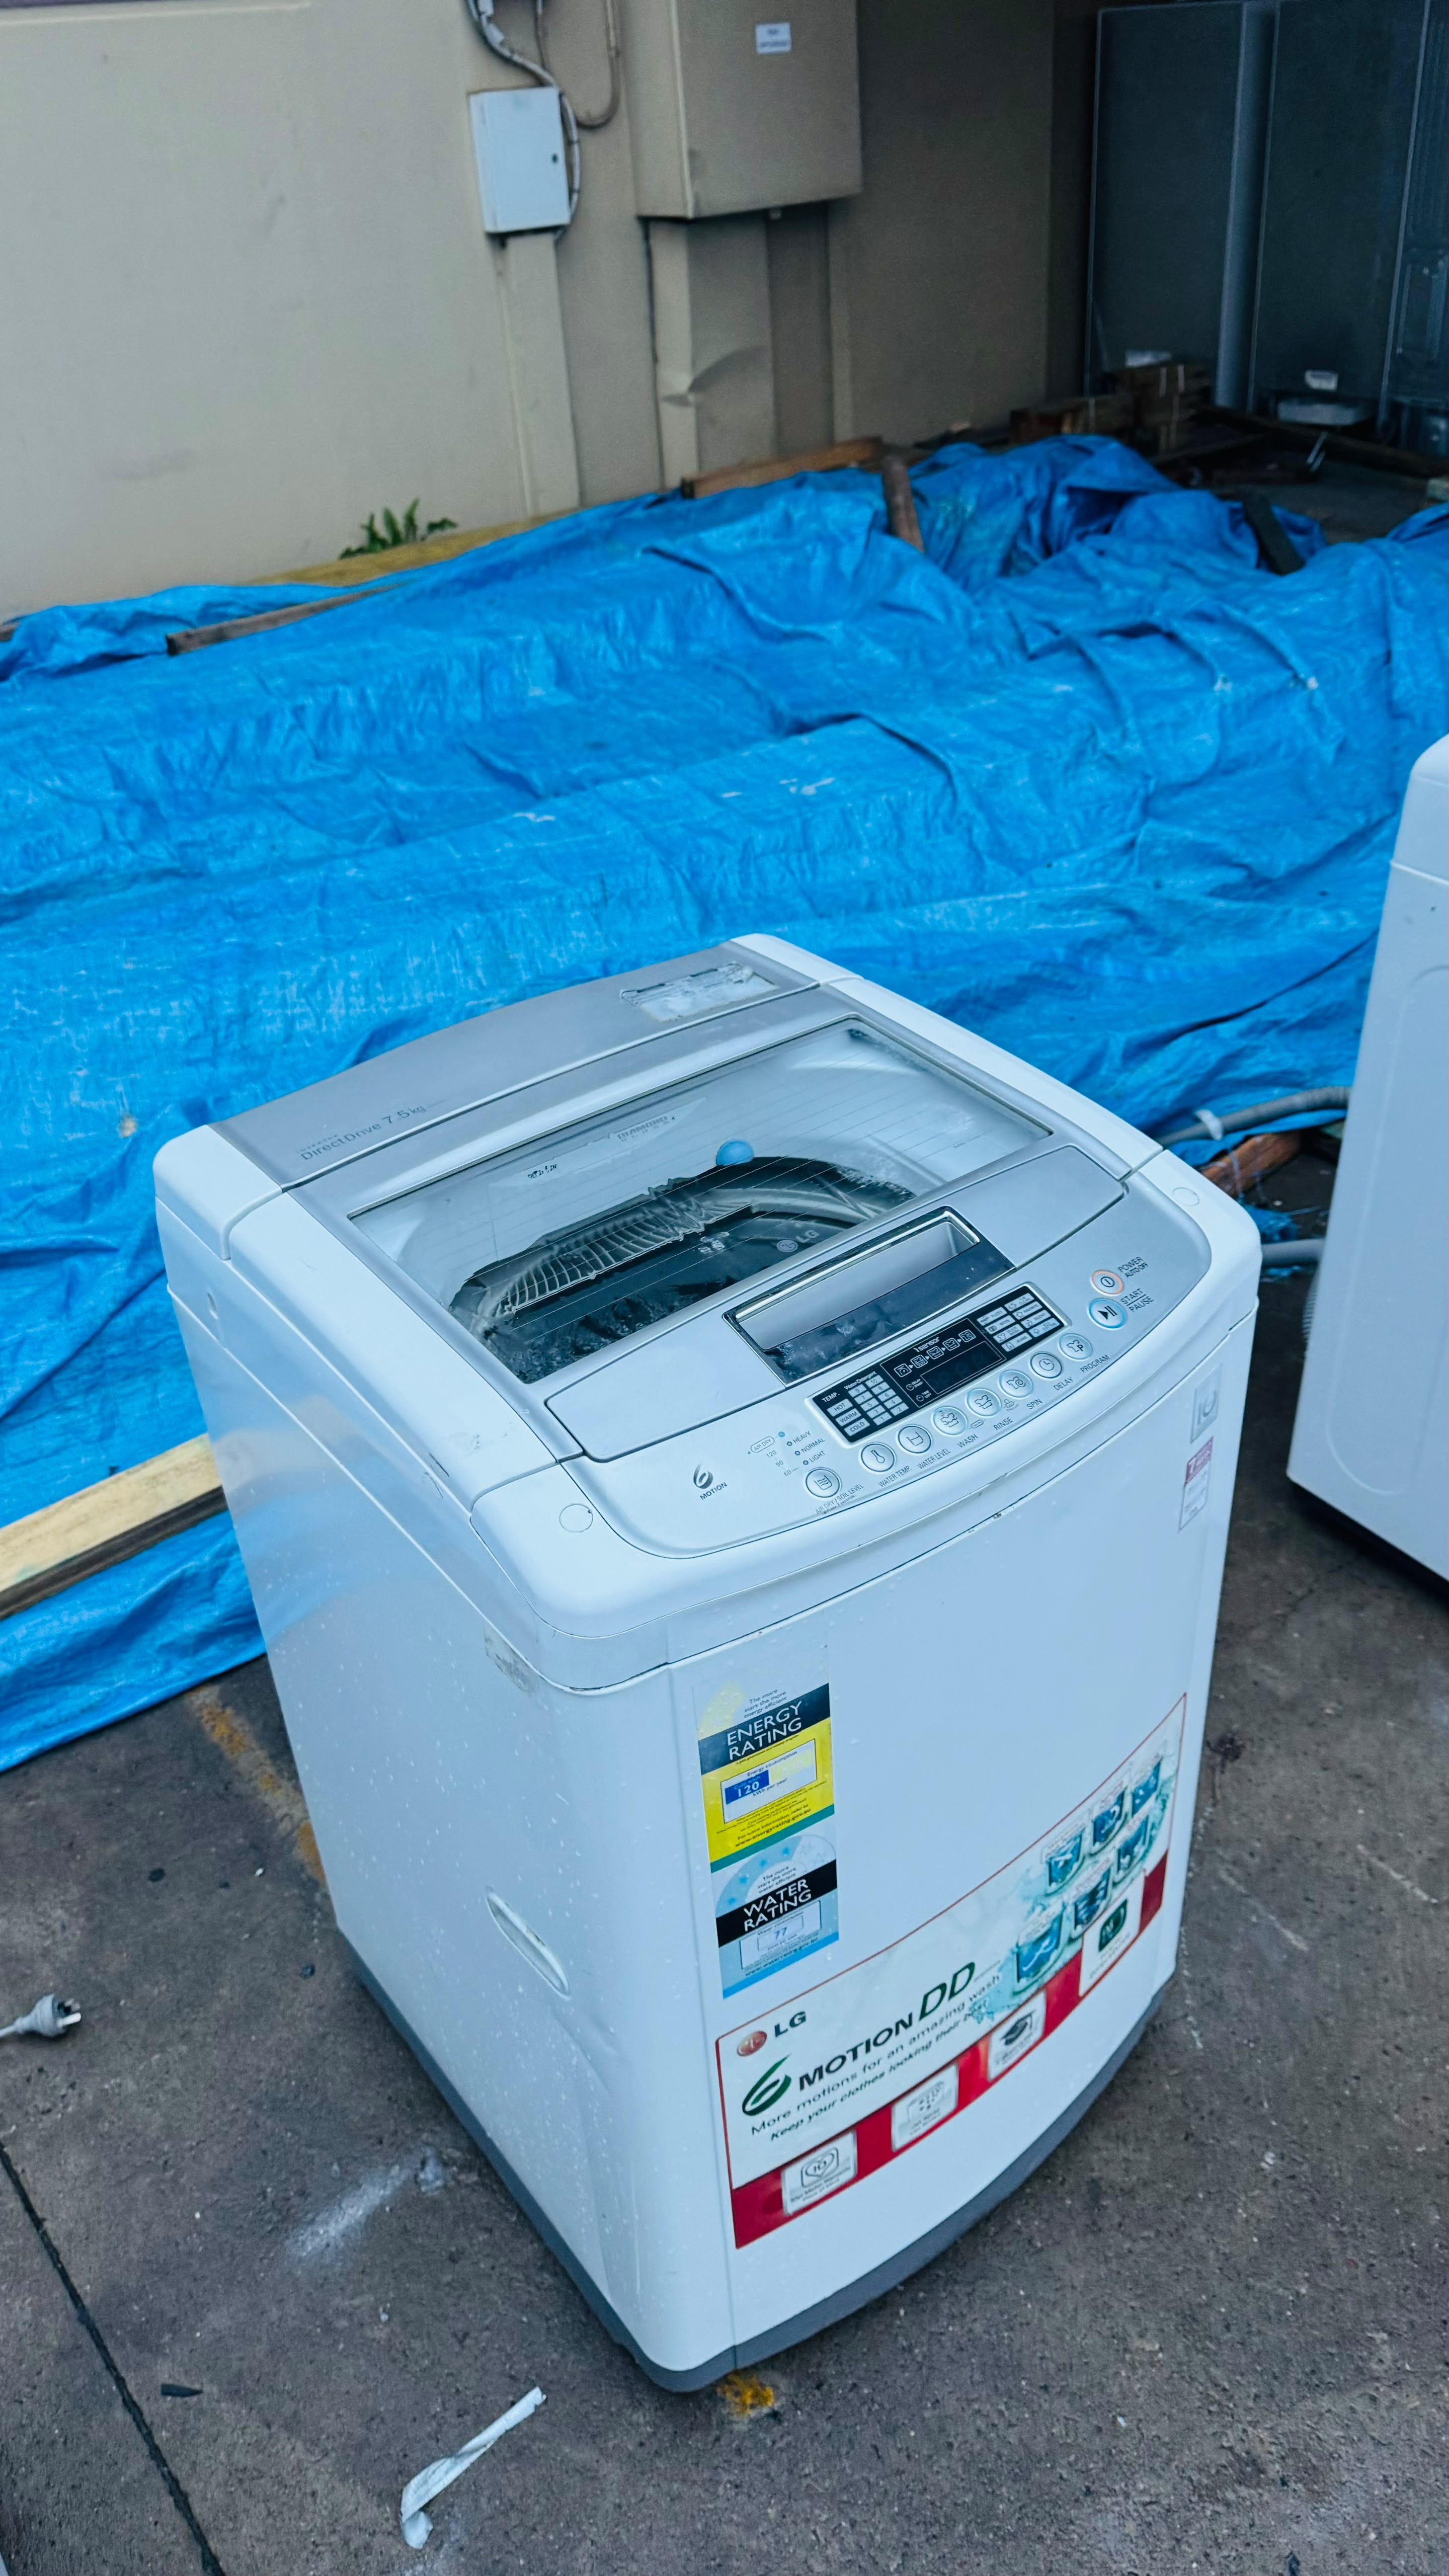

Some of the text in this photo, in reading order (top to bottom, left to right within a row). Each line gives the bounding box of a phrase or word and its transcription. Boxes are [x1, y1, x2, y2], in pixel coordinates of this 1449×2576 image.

[795, 1230, 819, 1243] LG
[1118, 1256, 1144, 1273] POWER
[1120, 1288, 1143, 1304] START
[1129, 1296, 1154, 1312] PAUSE
[1080, 1354, 1110, 1373] PROGRAM
[1054, 1376, 1074, 1391] DELAY
[822, 1392, 840, 1403] TEMP.
[1026, 1398, 1043, 1410] SPIN
[834, 1403, 846, 1412] HOT
[840, 1411, 858, 1423] WARM
[993, 1417, 1013, 1431] RINSE
[850, 1421, 865, 1432] COLD
[793, 1430, 812, 1444] HEAVY
[957, 1434, 979, 1448] WASH
[801, 1437, 826, 1454] NORMAL
[809, 1450, 826, 1463] LIGHT
[917, 1448, 951, 1470] WATER LEVEL
[877, 1473, 898, 1488] WATER
[700, 1482, 728, 1500] MOTION
[823, 1500, 835, 1509] DRY
[848, 1484, 864, 1495] LEVEL
[760, 1698, 770, 1706] the
[771, 1691, 786, 1701] more
[762, 1689, 778, 1699] more
[744, 1708, 763, 1719] energy
[727, 1700, 802, 1746] ENERGY
[729, 1717, 802, 1760] RATING
[737, 1781, 760, 1798] 120
[743, 1879, 809, 1917] WATER
[744, 1889, 812, 1932] RATING
[774, 1926, 787, 1940] 77
[774, 2011, 807, 2038] LG
[798, 2010, 913, 2092] MOTION
[918, 1962, 976, 2022] DD
[751, 1975, 1000, 2135] More motions for an amazing wash
[770, 2118, 804, 2142] Keep
[808, 2100, 837, 2124] your
[840, 2071, 886, 2103] clothes
[889, 2040, 933, 2073] looking
[935, 2020, 961, 2042] their
